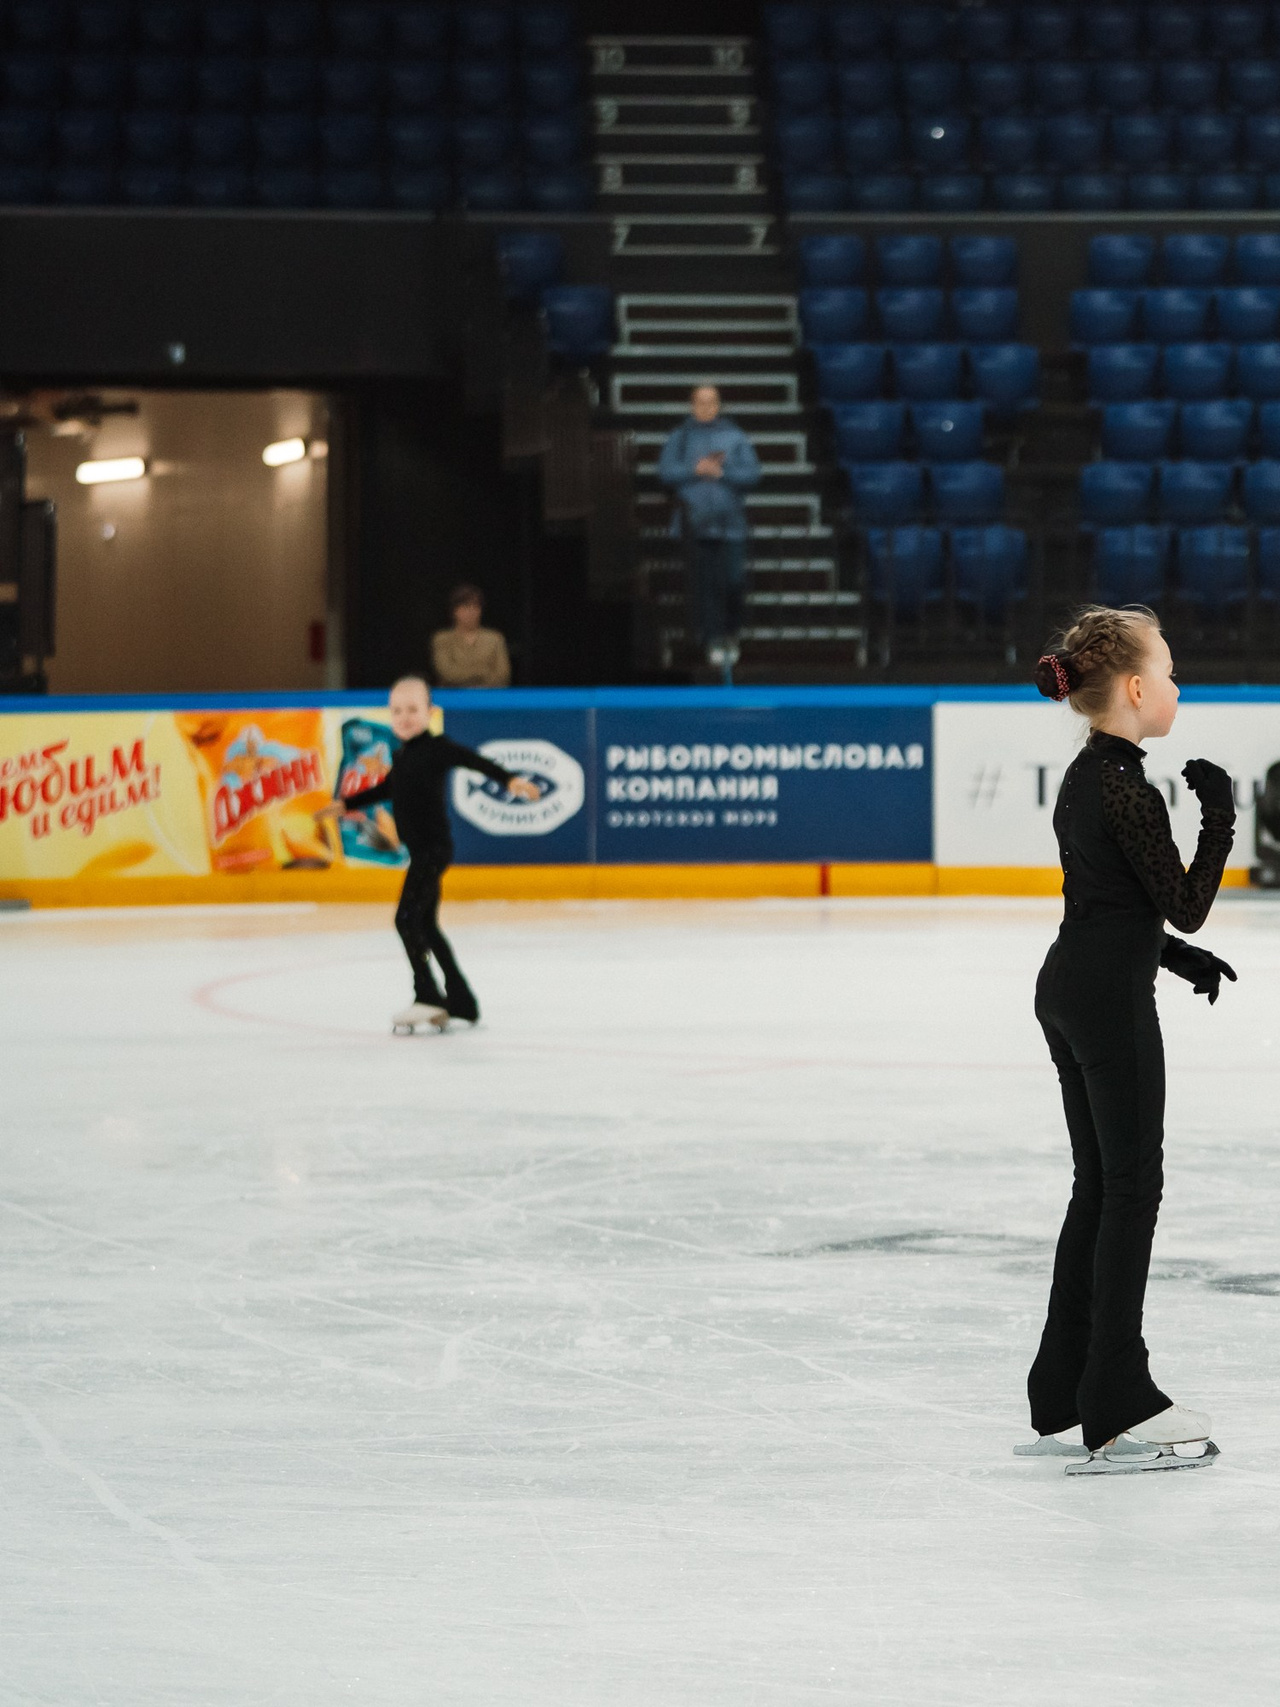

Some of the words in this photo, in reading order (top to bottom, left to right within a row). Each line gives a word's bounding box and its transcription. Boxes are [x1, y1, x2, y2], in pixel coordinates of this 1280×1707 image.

[613, 222, 630, 250] 7
[750, 222, 768, 250] 7
[606, 744, 925, 771] РЫБОПРОМЫСЛОВАЯ
[606, 775, 779, 801] КОМПАНИЯ
[722, 810, 778, 827] МОРЕ
